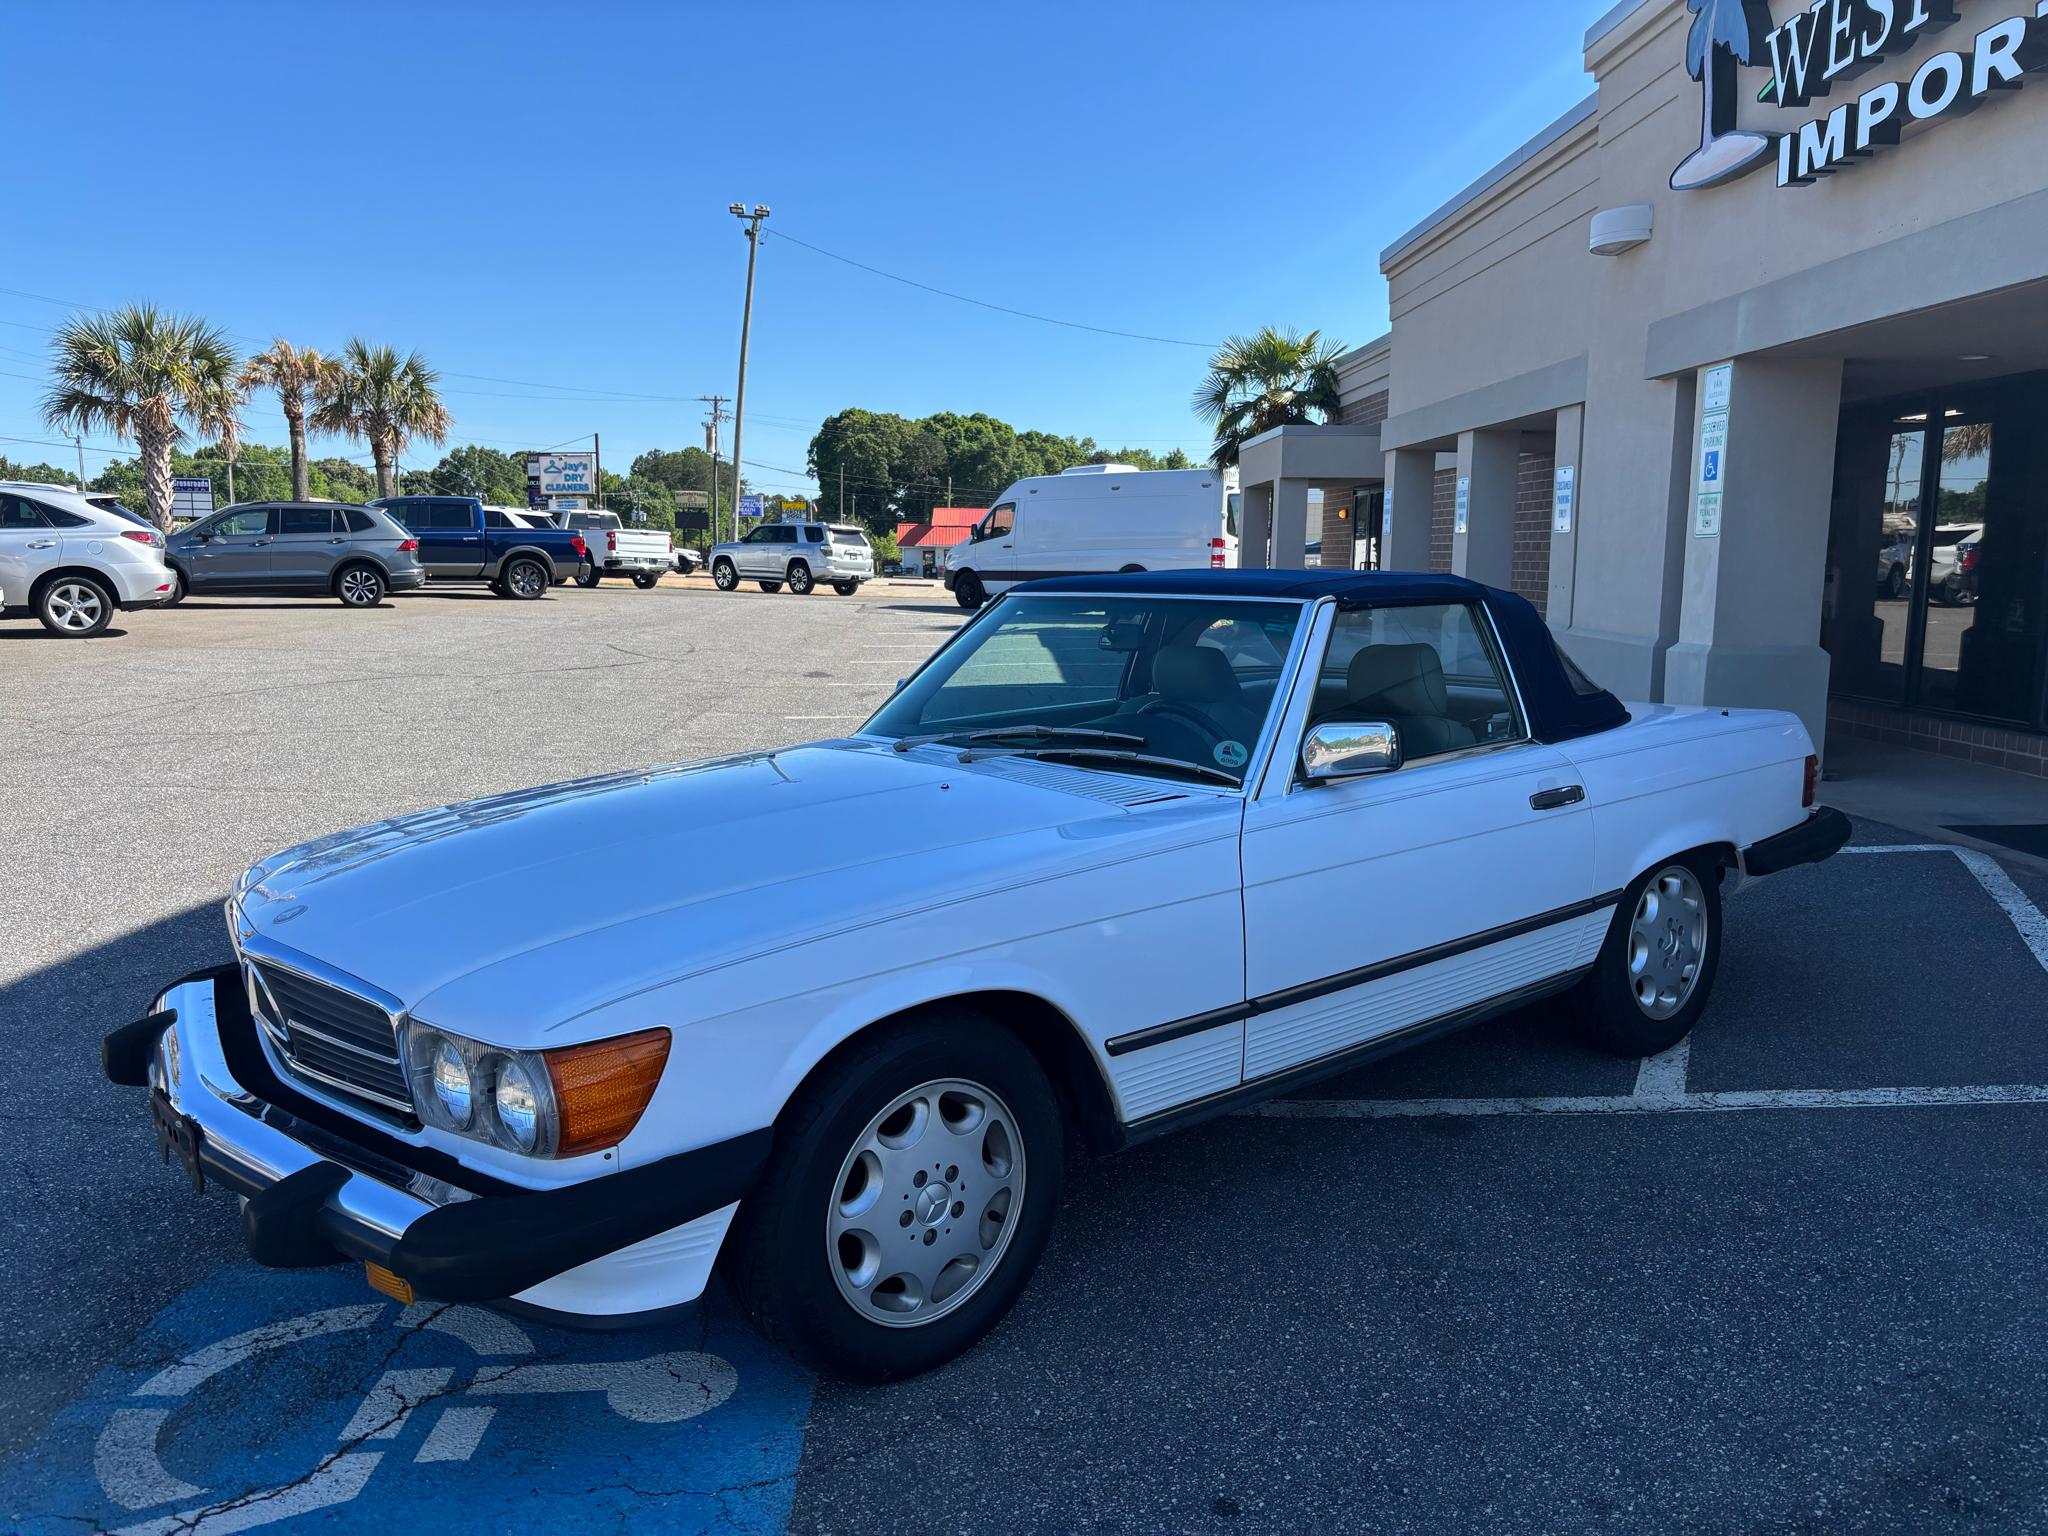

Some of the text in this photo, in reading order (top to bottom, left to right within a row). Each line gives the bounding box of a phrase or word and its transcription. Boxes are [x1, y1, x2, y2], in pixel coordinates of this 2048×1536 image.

[1776, 0, 2048, 188] IMPOR
[1702, 420, 1725, 434] RESERVED
[1703, 435, 1723, 448] PARKING
[562, 461, 589, 472] Jay's
[564, 474, 584, 482] DRY
[545, 484, 590, 492] CLEANERS
